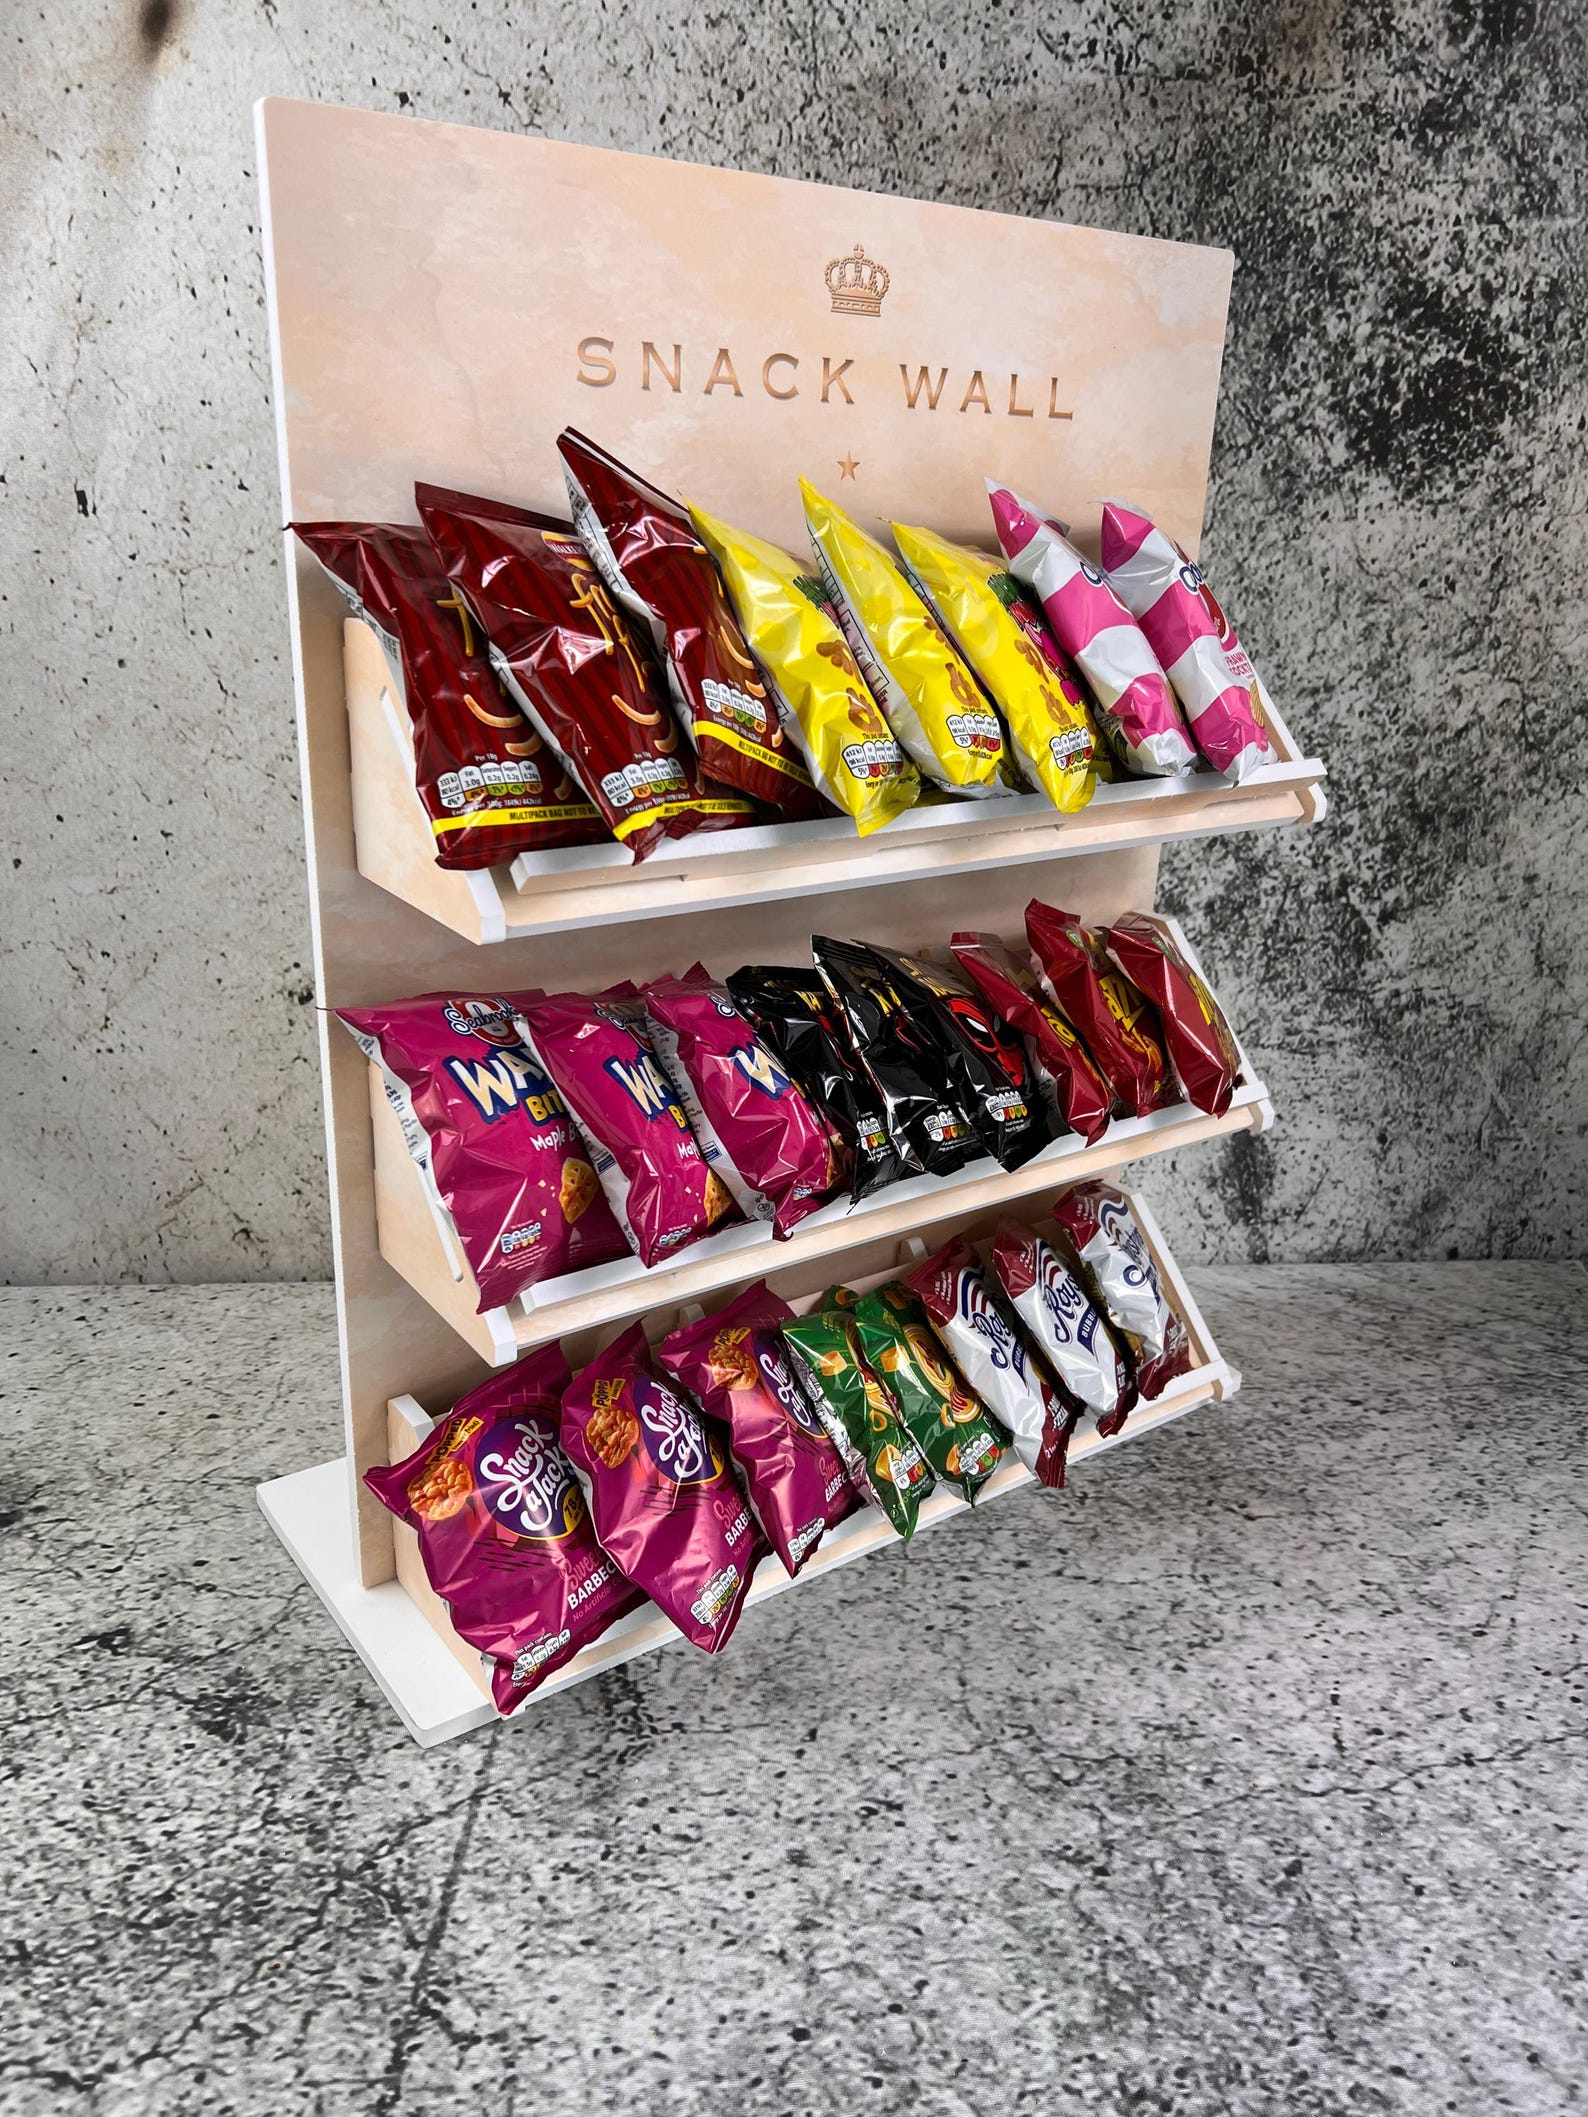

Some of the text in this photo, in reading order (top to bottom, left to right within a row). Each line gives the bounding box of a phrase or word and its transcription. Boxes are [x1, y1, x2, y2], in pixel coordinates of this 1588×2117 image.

[576, 336, 1073, 421] SNACK WALL
[465, 778, 481, 788] 3.0g
[487, 774, 502, 783] 0.2g
[509, 810, 548, 820] MULTIPACK
[549, 808, 563, 818] BAG
[564, 806, 578, 816] NOT
[579, 805, 588, 815] TO
[529, 1126, 566, 1151] Maple
[431, 1418, 464, 1463] POPPED
[480, 1419, 553, 1511] Snack
[567, 1560, 617, 1610] BARBEC
[573, 1609, 584, 1622] No
[515, 1646, 524, 1656] This
[524, 1642, 535, 1652] pack
